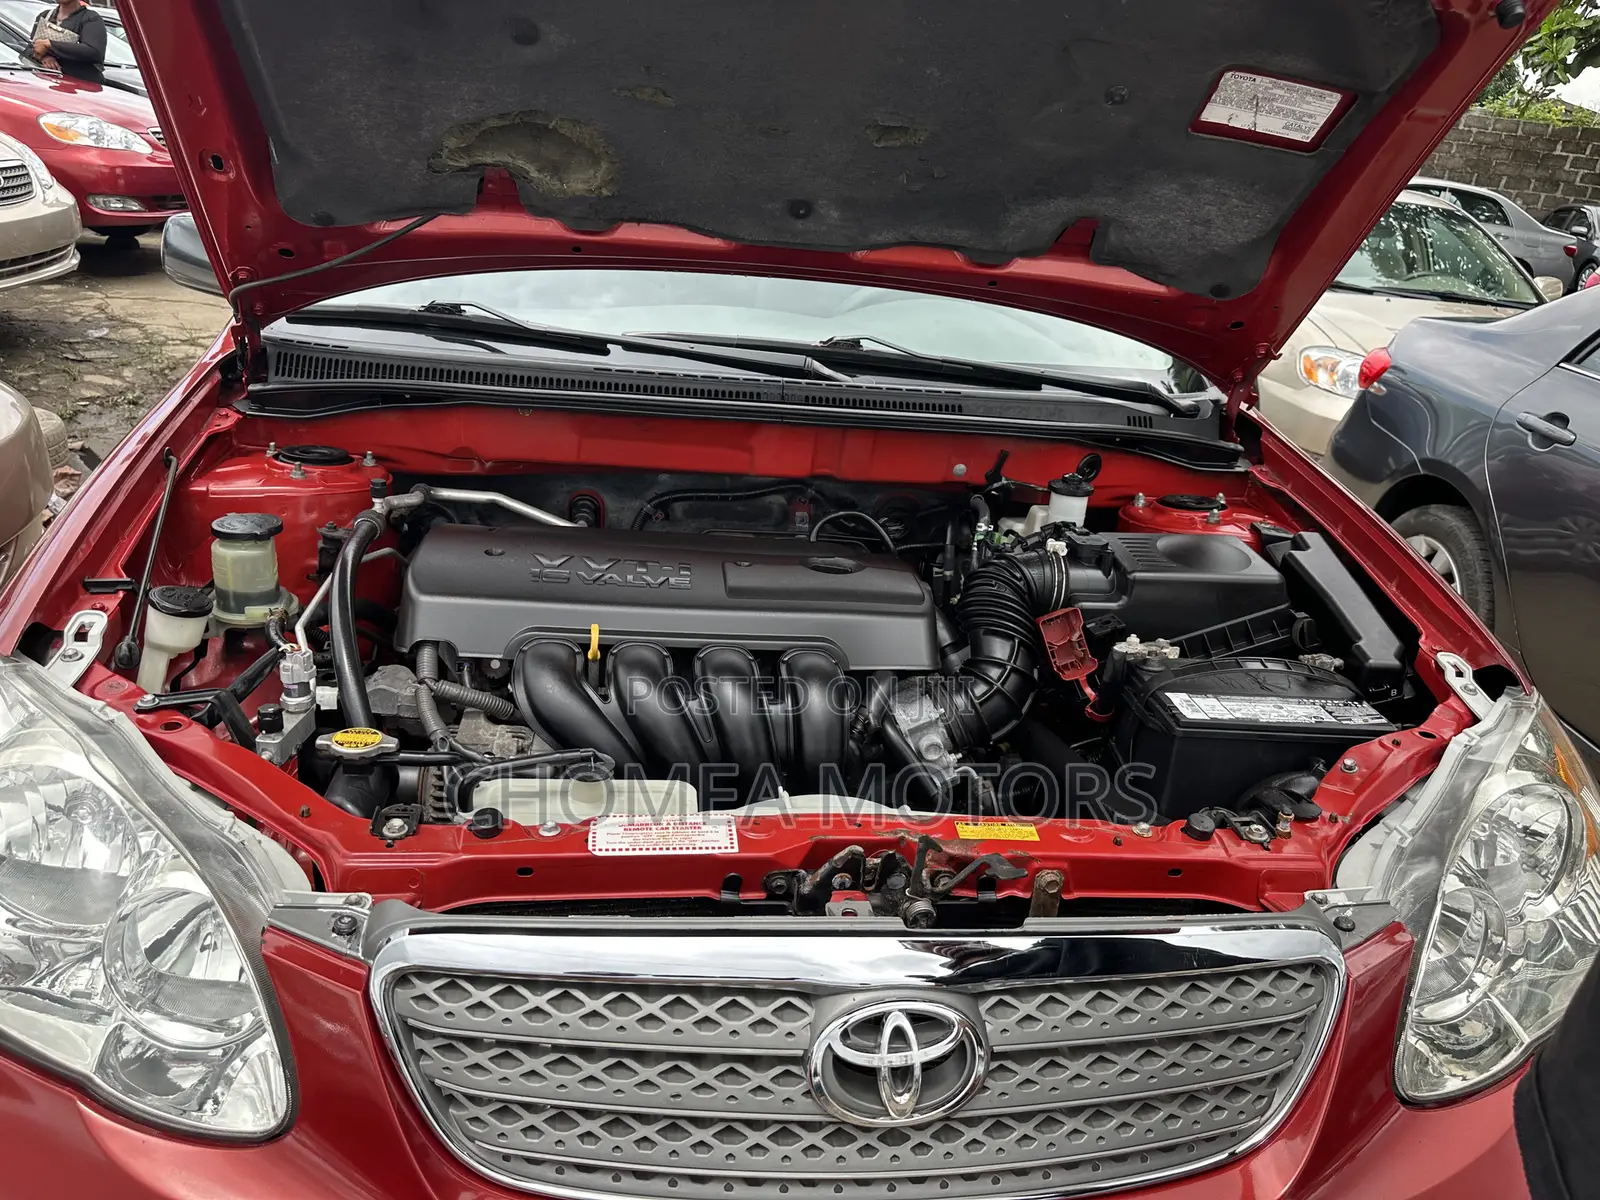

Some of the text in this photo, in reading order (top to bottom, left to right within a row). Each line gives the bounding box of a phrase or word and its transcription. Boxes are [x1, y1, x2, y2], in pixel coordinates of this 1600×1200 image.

[1230, 73, 1257, 83] TOYOTA
[1284, 121, 1316, 131] CATALYST
[530, 568, 691, 590] 16 VALVE
